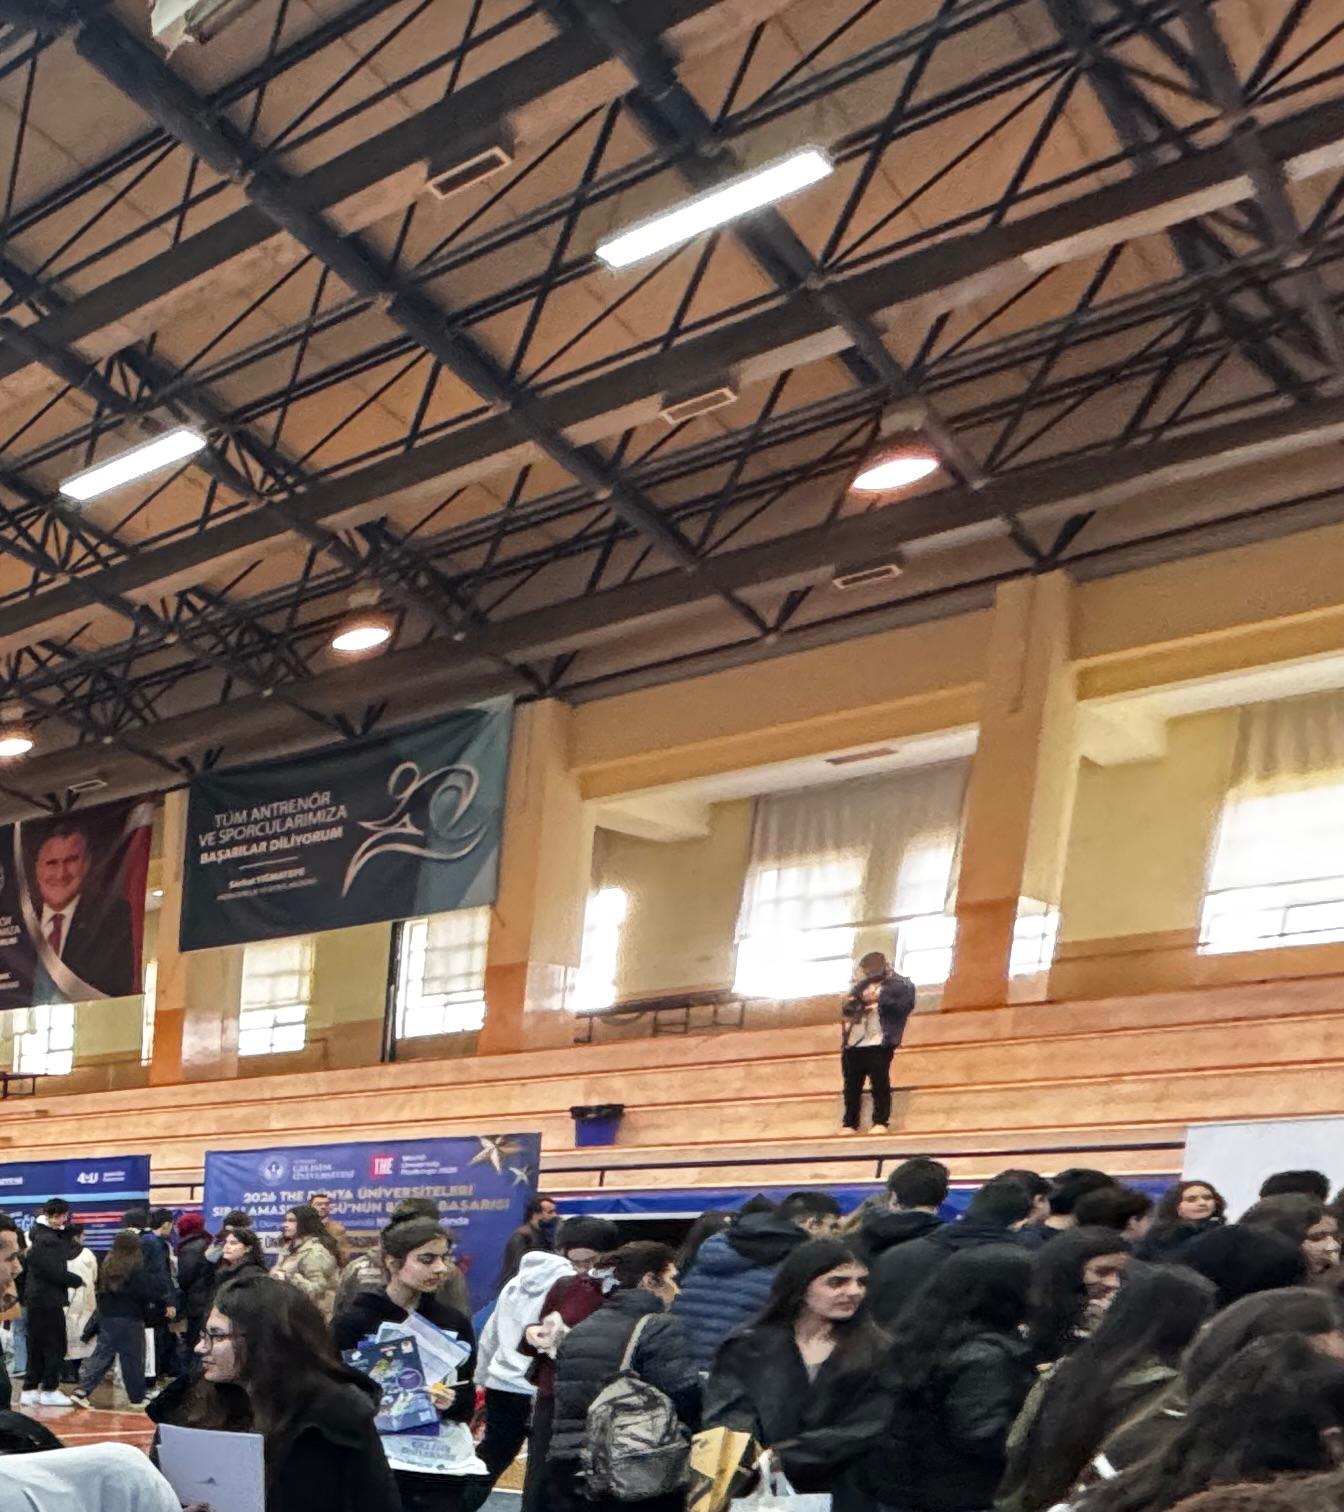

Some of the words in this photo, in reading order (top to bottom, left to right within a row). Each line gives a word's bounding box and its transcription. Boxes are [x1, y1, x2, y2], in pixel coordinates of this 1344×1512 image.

[198, 831, 216, 847] VE
[219, 805, 348, 845] SPORCULARIMIZA
[215, 811, 248, 828] TÜM
[252, 791, 331, 821] ANTRENÖR
[200, 841, 268, 865] BAŞARILAR
[269, 826, 344, 852] DİLİYORUM
[280, 1190, 304, 1202] THE
[358, 1184, 474, 1199] ÜNİVERSİTELERİ
